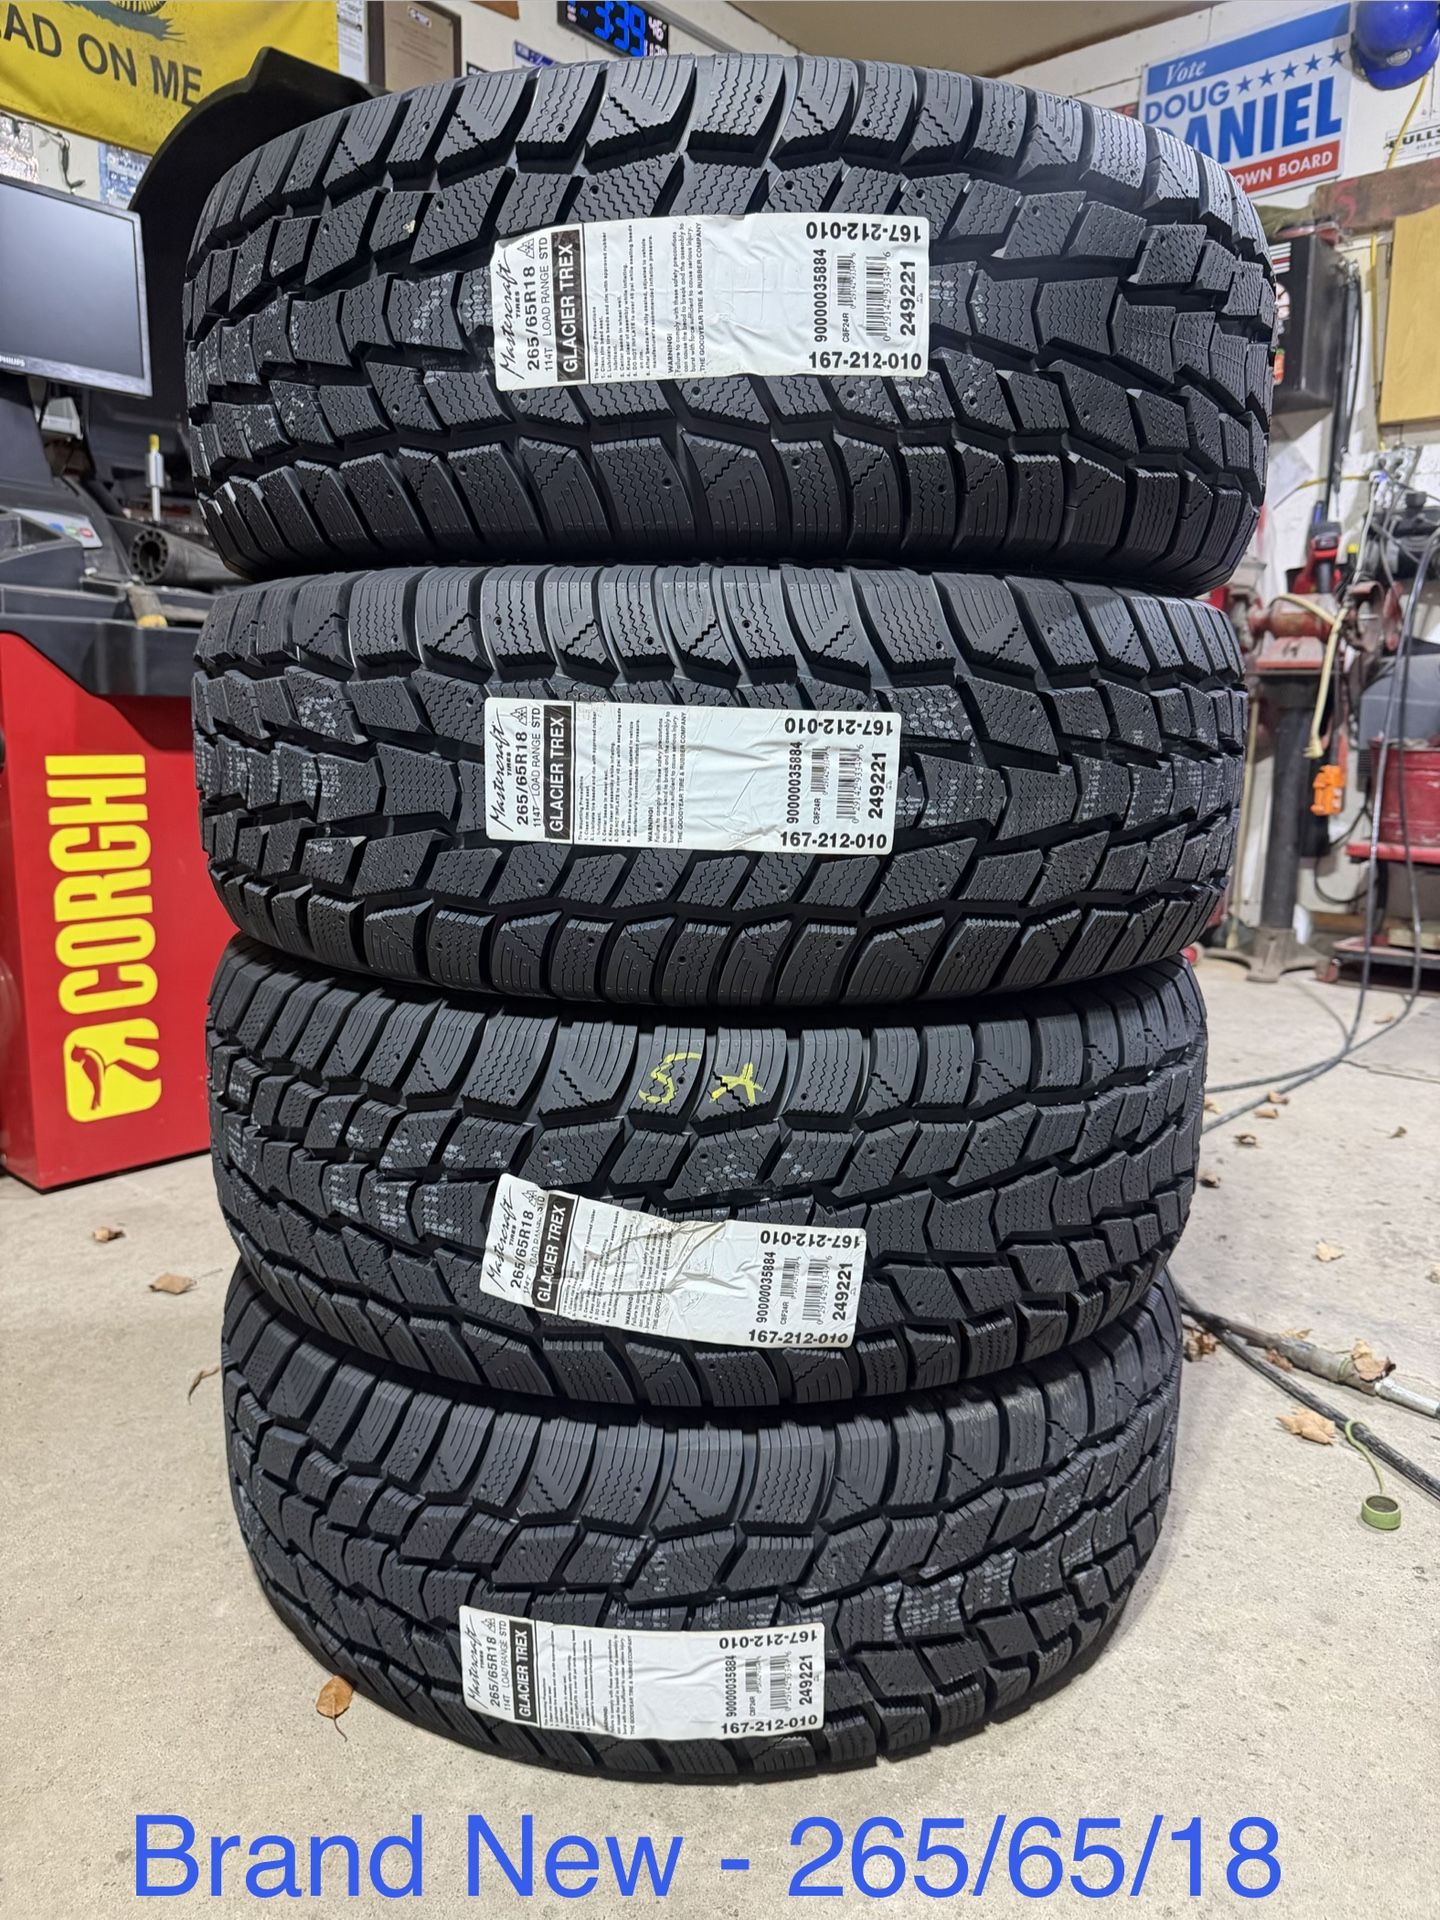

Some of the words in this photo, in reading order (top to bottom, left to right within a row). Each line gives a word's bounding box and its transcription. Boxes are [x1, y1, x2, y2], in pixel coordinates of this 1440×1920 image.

[0, 3, 61, 58] AD
[77, 33, 137, 86] ON
[150, 54, 202, 107] ME
[1164, 56, 1207, 85] Vote
[1145, 80, 1230, 124] DOUG
[1156, 75, 1342, 164] ANIEL
[1234, 165, 1273, 188] OWN
[1278, 150, 1333, 178] BOARD
[539, 238, 548, 259] STD
[806, 222, 921, 243] 167-212-010
[540, 266, 550, 303] RANGE
[558, 244, 574, 291] TREX
[497, 248, 525, 380] Mastercraft
[523, 266, 540, 371] 265/65R18
[813, 249, 827, 342] 90000035884
[900, 262, 915, 336] 249221
[541, 307, 552, 336] LOAD
[561, 296, 578, 372] GLACIER
[544, 347, 553, 371] 114T
[809, 352, 921, 370] 167-212-010
[532, 708, 540, 728] STD
[550, 717, 564, 758] TREX
[784, 717, 893, 736] 167-212-010
[489, 707, 514, 832] Mastercraft
[532, 734, 540, 767] RANGE
[515, 732, 528, 825] 265/65R18
[532, 770, 540, 796] LOAD
[550, 764, 564, 832] GLACIER
[787, 742, 802, 824] 90000035884
[868, 753, 886, 819] 249221
[533, 806, 541, 827] 114T
[781, 832, 886, 848] 167-212-010
[45, 754, 159, 1015] CORGHI
[487, 1185, 516, 1292] Mastercraft
[510, 1210, 534, 1288] 265/65R18
[537, 1245, 559, 1302] GLACIER
[548, 1204, 566, 1240] TREX
[760, 1230, 860, 1248] 167-212-010
[756, 1252, 776, 1323] 90000035884
[832, 1263, 852, 1321] 249221
[749, 1329, 848, 1344] 167-212-010
[499, 1621, 507, 1636] STD
[515, 1630, 528, 1662] TREX
[719, 1629, 818, 1649] 167-212-010
[464, 1615, 488, 1709] Mastercraft
[487, 1637, 500, 1707] 265/65R18
[500, 1640, 508, 1666] RANGE
[517, 1665, 531, 1716] GLACIER
[725, 1655, 737, 1717] 90000035884
[799, 1655, 812, 1705] 249221
[721, 1715, 818, 1734] 167-212-010
